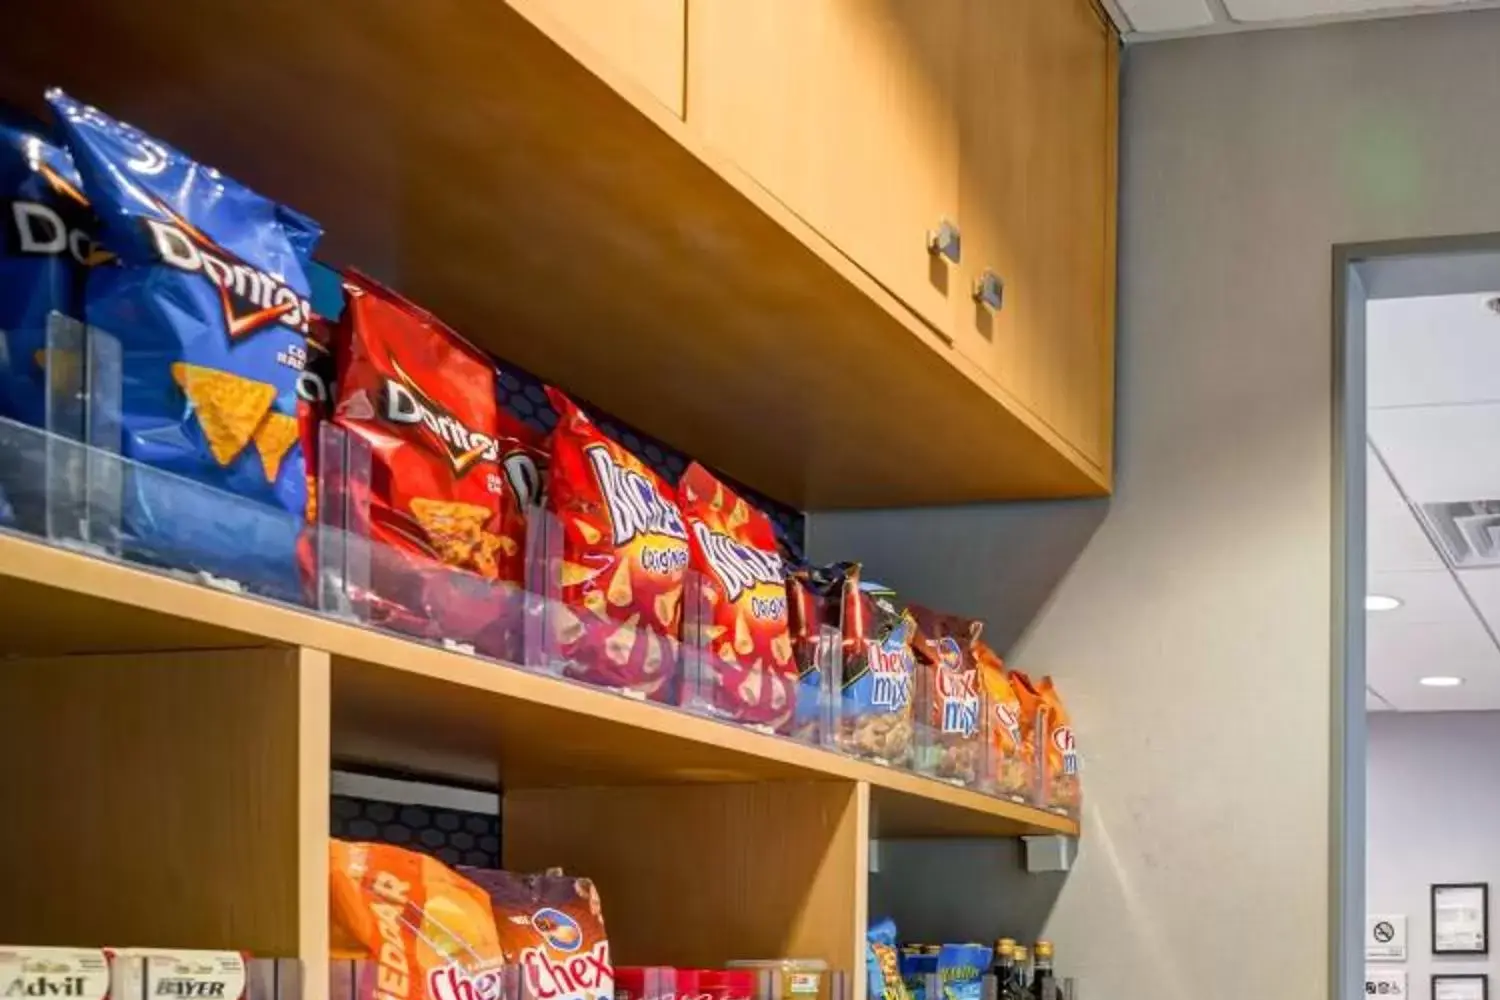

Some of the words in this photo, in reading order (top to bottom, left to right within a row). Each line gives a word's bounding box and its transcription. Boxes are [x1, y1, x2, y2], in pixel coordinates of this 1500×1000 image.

[588, 446, 687, 545] BUGLE
[5, 976, 87, 997] Advil
[155, 981, 225, 996] BAYER
[525, 945, 613, 999] Chex
